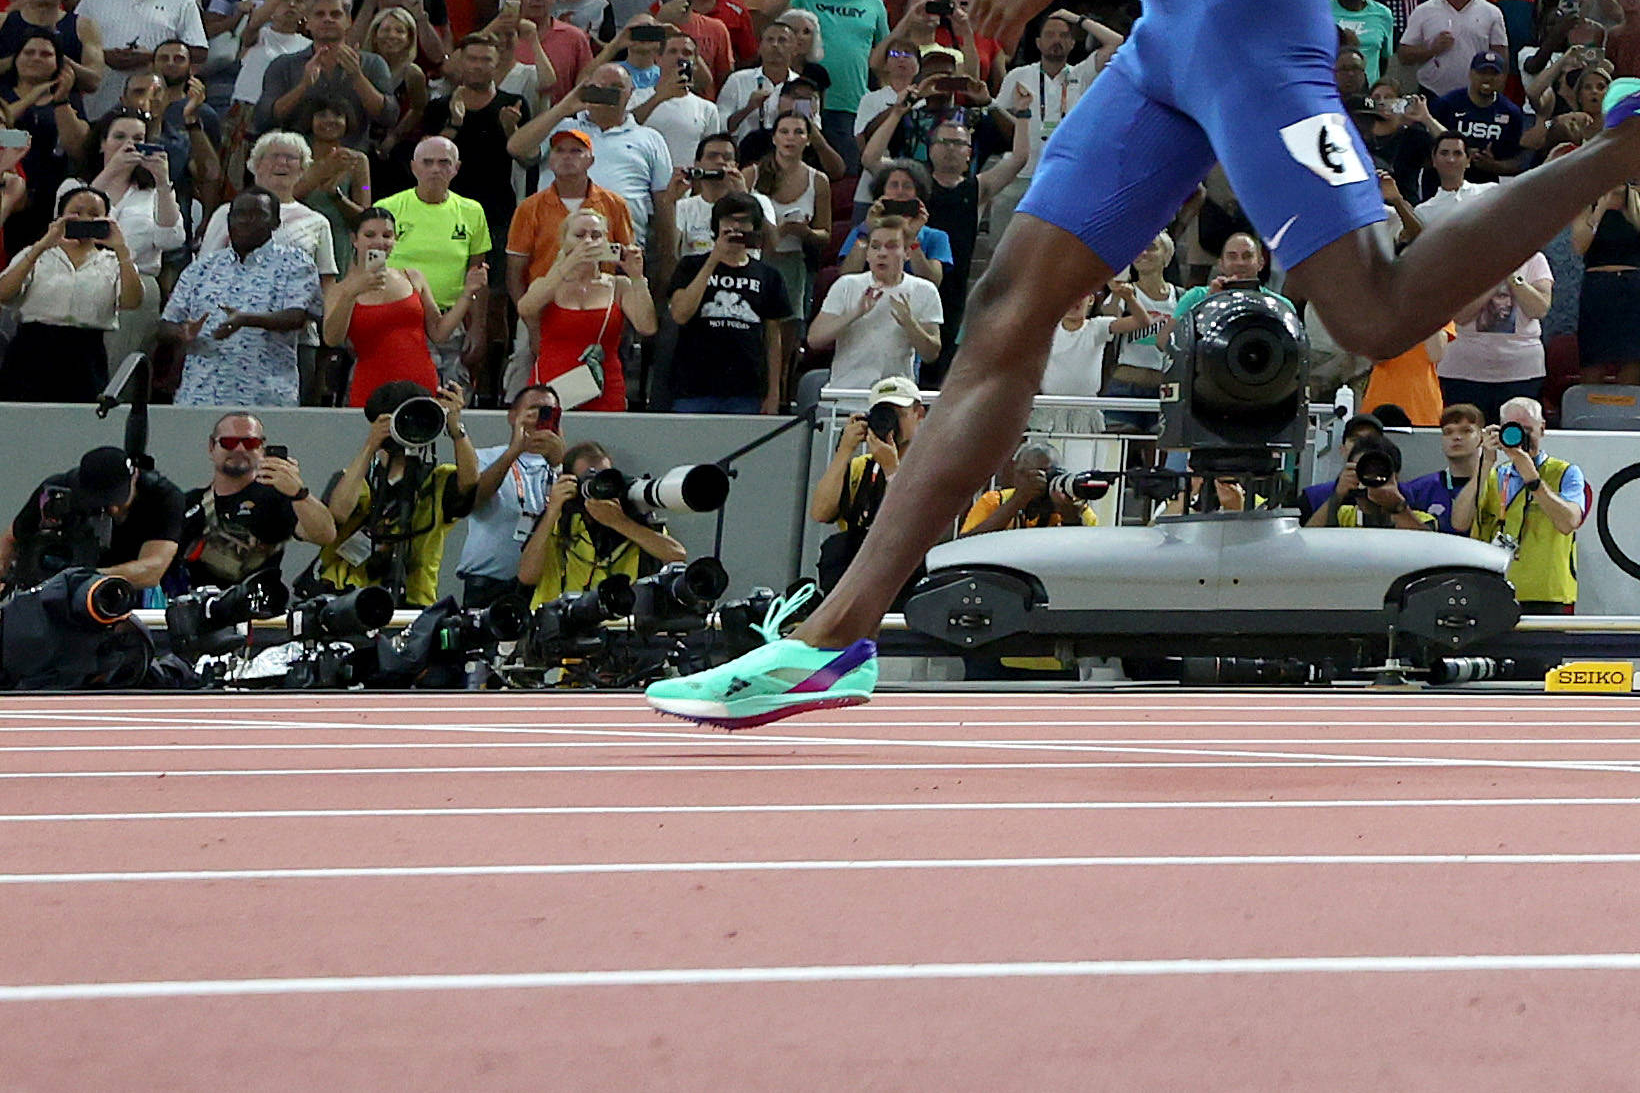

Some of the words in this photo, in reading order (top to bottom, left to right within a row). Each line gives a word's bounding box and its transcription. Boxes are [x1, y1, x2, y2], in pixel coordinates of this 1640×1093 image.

[1457, 120, 1502, 140] USA
[707, 274, 761, 294] NOPE
[1558, 670, 1625, 685] SEIKO
